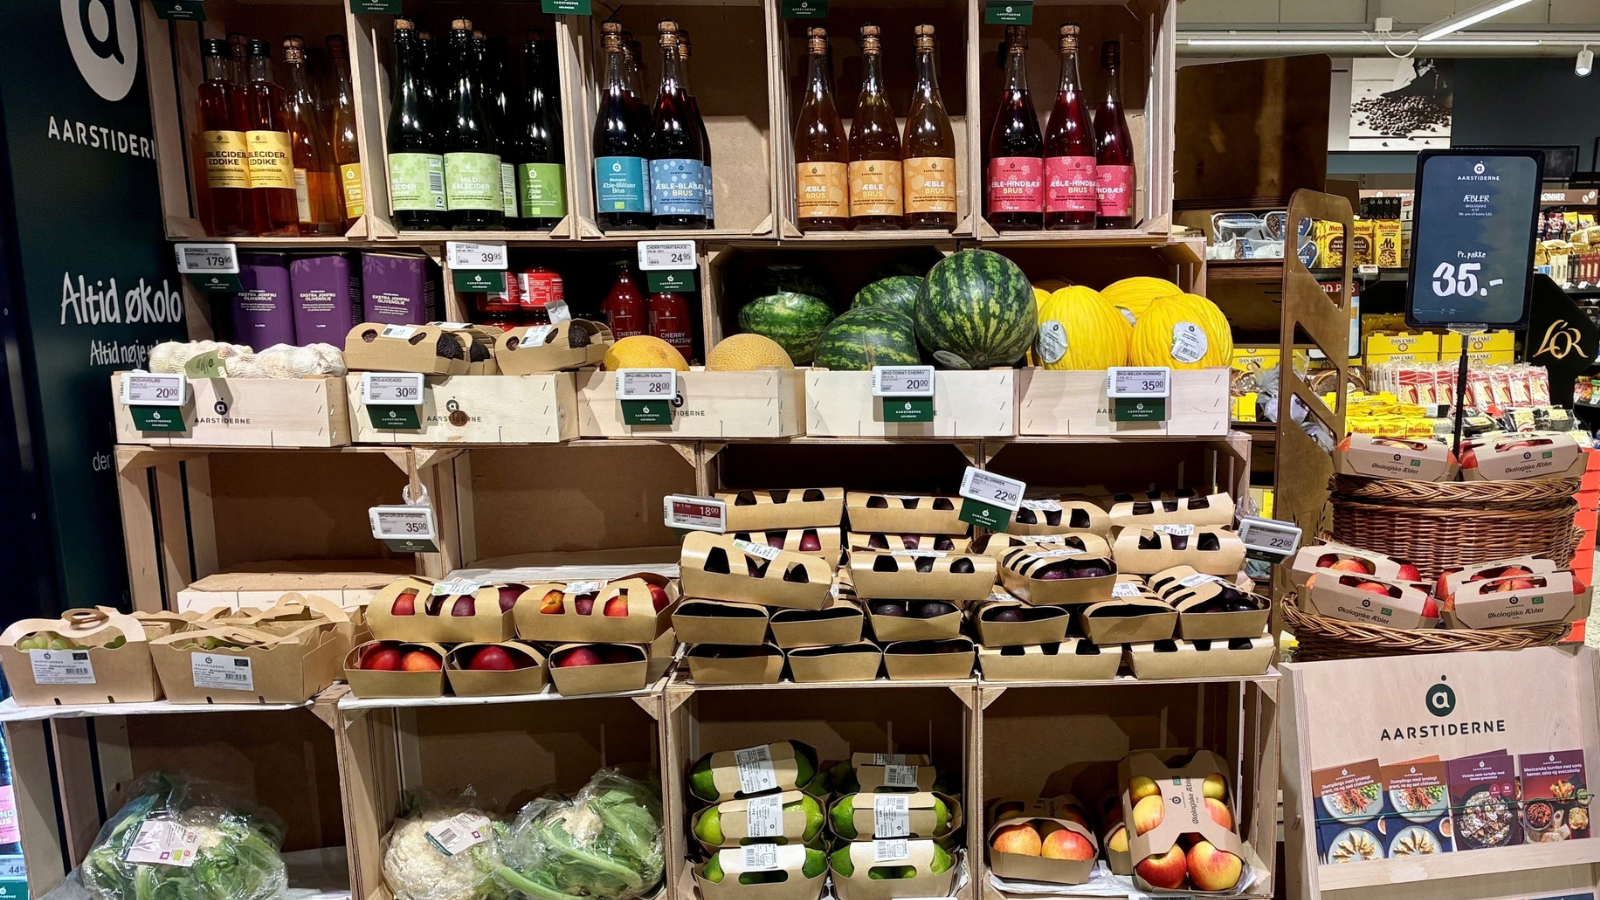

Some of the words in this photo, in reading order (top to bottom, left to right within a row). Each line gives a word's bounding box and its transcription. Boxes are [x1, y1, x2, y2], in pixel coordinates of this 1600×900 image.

[1463, 194, 1490, 202] ÆBLER
[1467, 250, 1486, 259] pakke
[60, 271, 122, 325] Altid
[90, 340, 120, 366] Altid
[120, 340, 146, 368] nøje
[92, 452, 111, 472] der
[1338, 606, 1371, 620] Økologiske
[1488, 609, 1524, 619] Økologiske
[1380, 720, 1506, 741] AARSTIDERNE
